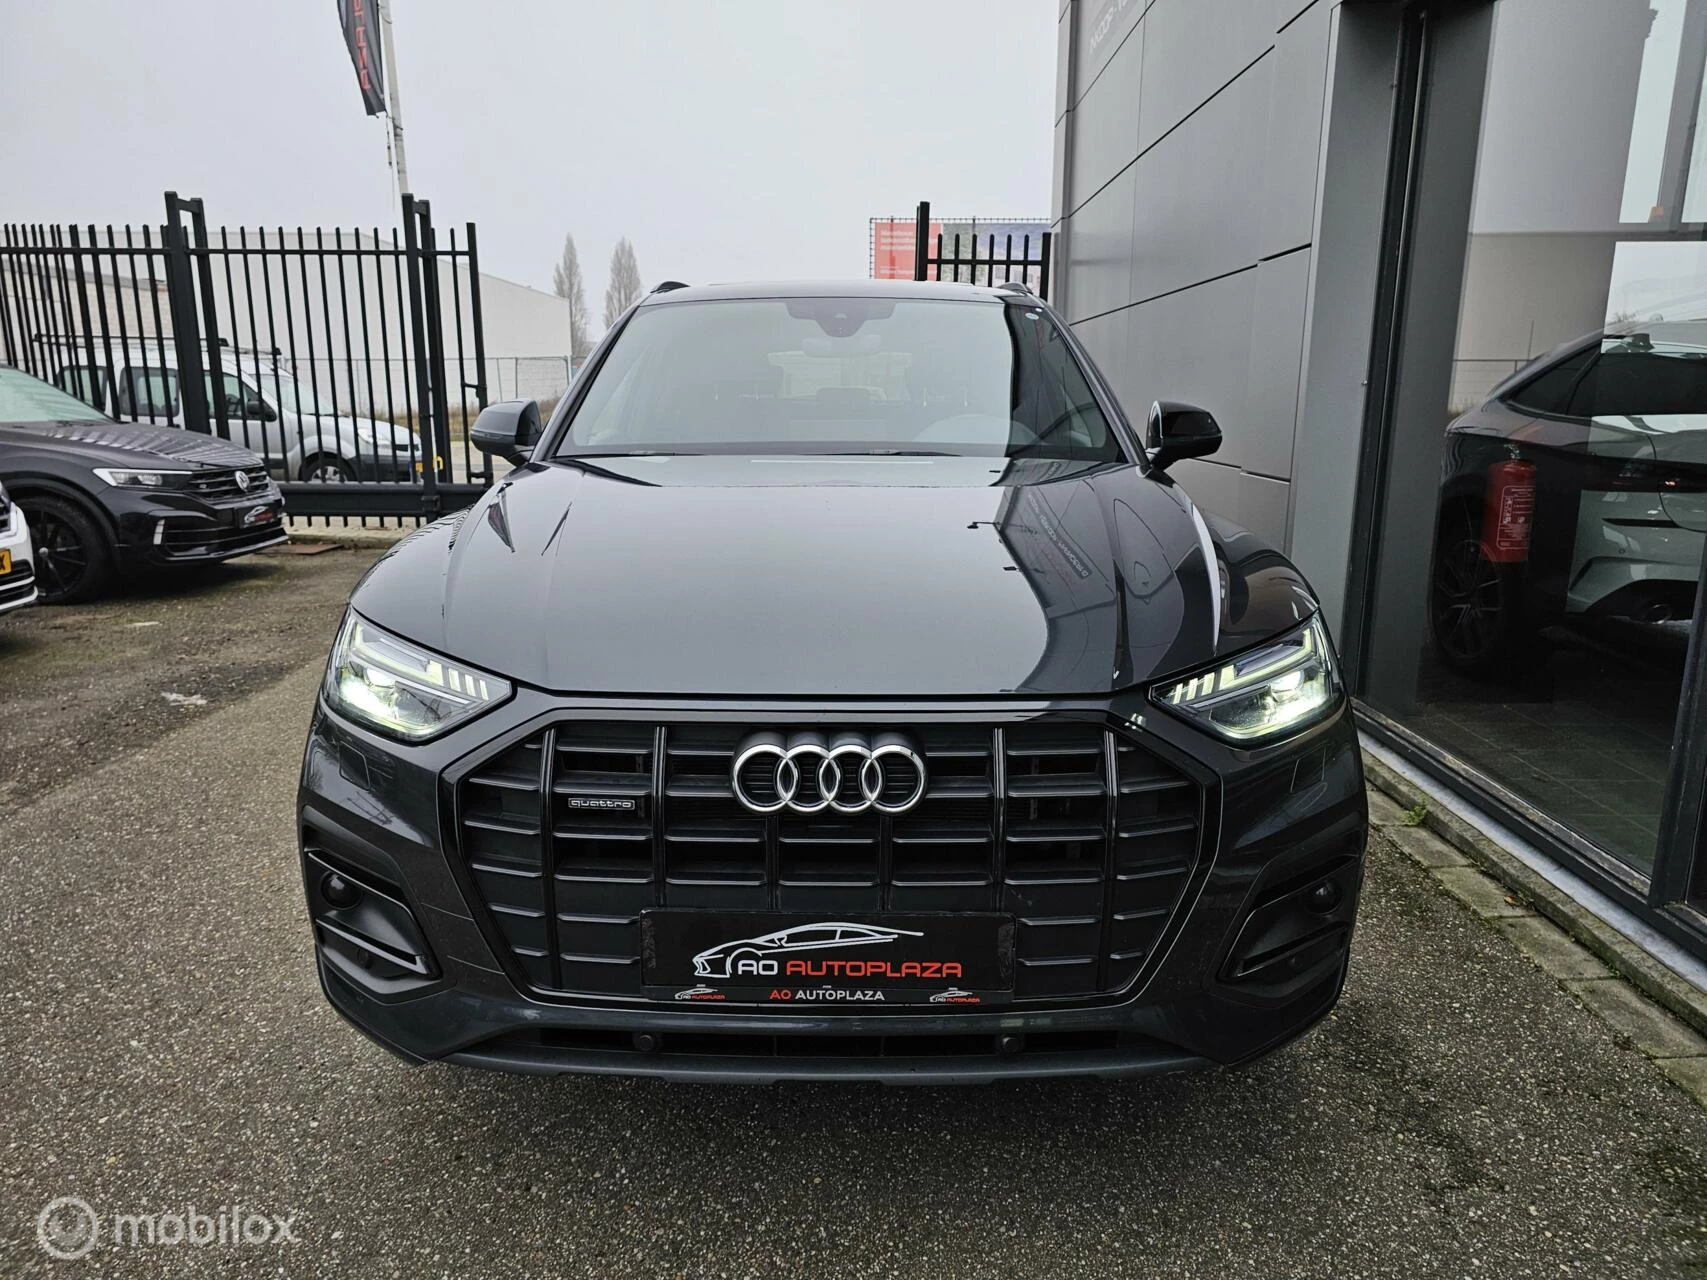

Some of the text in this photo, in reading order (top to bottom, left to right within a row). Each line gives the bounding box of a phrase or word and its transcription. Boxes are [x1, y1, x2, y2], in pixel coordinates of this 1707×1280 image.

[571, 800, 632, 808] quattro
[737, 959, 962, 978] AO AUTOPLAZA
[769, 989, 886, 1001] AO AUTOPLAZA
